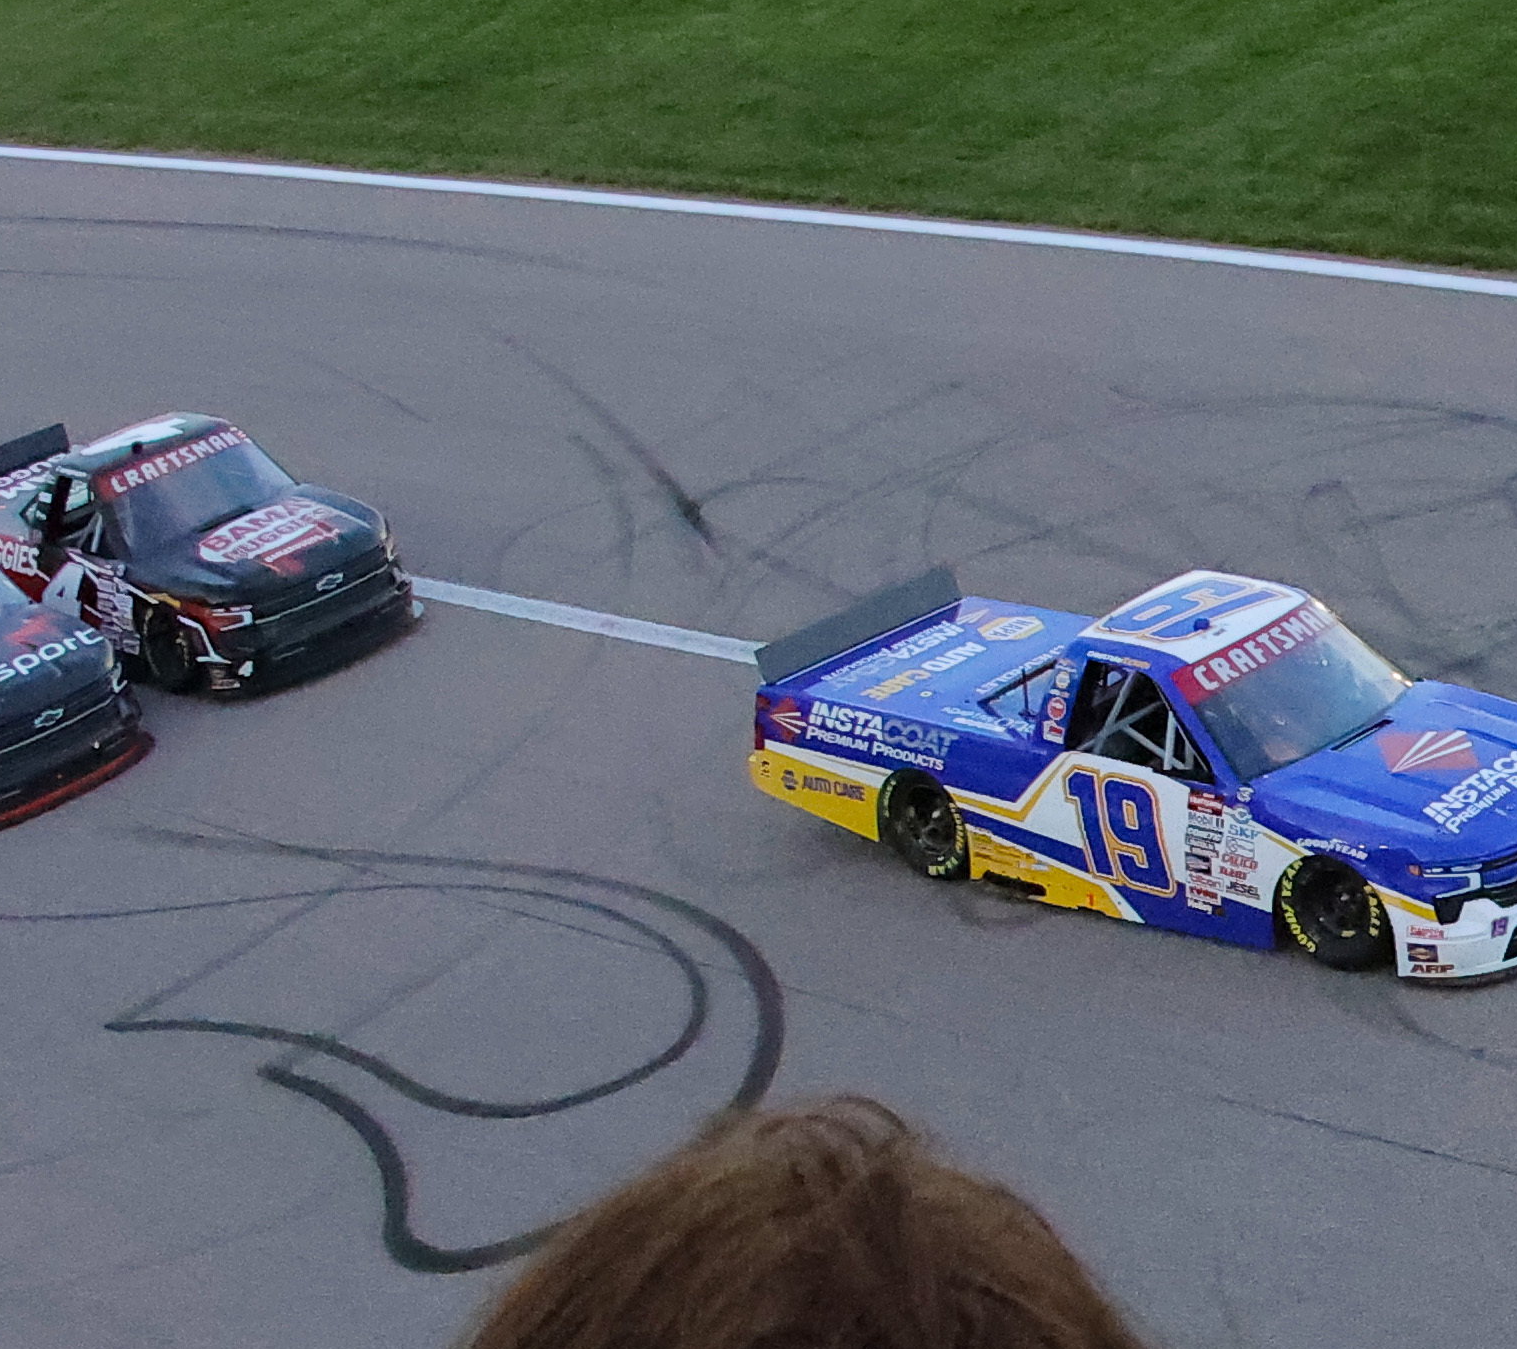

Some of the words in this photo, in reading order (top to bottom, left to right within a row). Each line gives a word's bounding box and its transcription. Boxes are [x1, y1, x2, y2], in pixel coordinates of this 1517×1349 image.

[110, 430, 240, 494] CRAFTSMAN
[41, 561, 84, 617] 4
[1094, 576, 1289, 643] 19
[919, 641, 988, 672] AUTO
[1193, 604, 1334, 692] CRAFTSMAN
[805, 725, 869, 752] PREMIUM
[870, 743, 945, 771] PRODUCTS
[802, 775, 832, 795] AUTO
[833, 779, 866, 802] CARE
[1445, 784, 1512, 835] PREMIUM
[1065, 766, 1177, 898] 19
[1228, 823, 1261, 840] SKF
[1297, 837, 1370, 861] GOODYEAR
